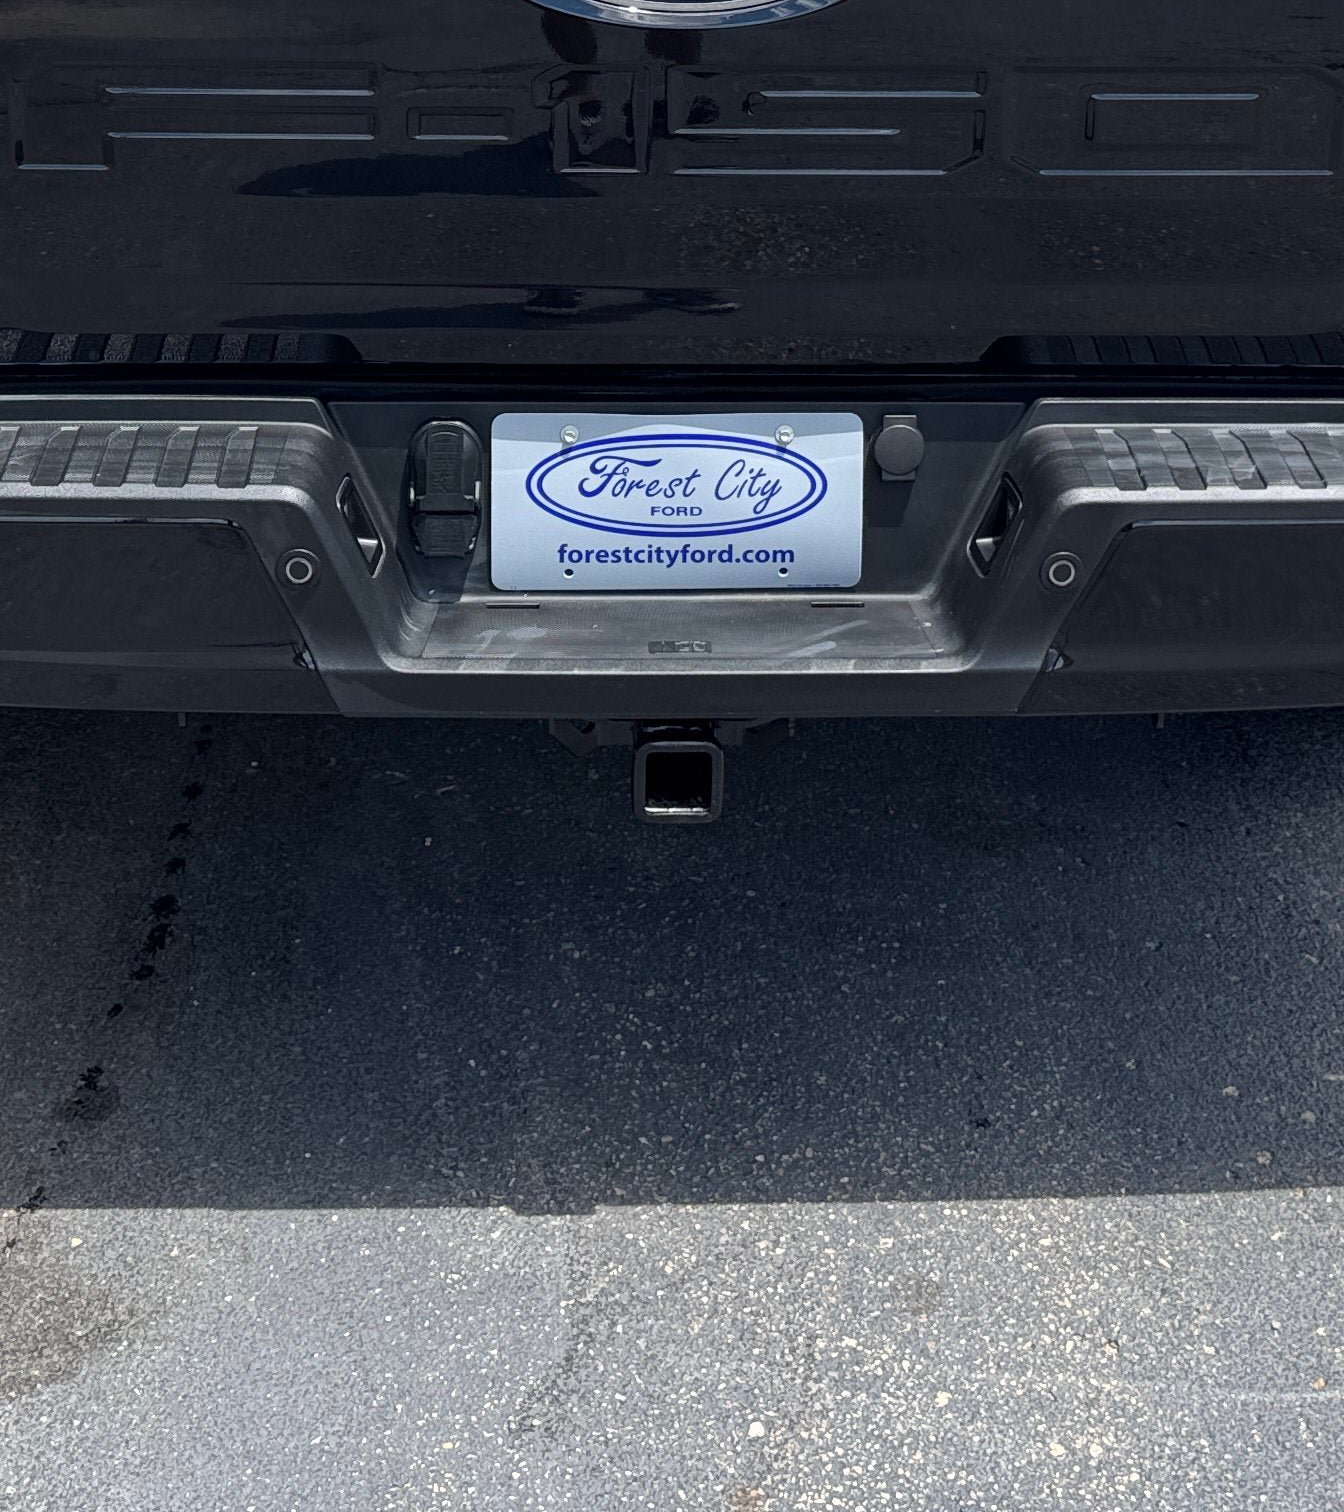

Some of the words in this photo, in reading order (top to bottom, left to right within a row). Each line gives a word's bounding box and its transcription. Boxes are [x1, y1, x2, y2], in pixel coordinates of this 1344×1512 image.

[577, 454, 702, 500] Forest
[714, 458, 783, 515] City
[650, 506, 703, 517] FORD
[557, 544, 796, 569] forestcityford.com
